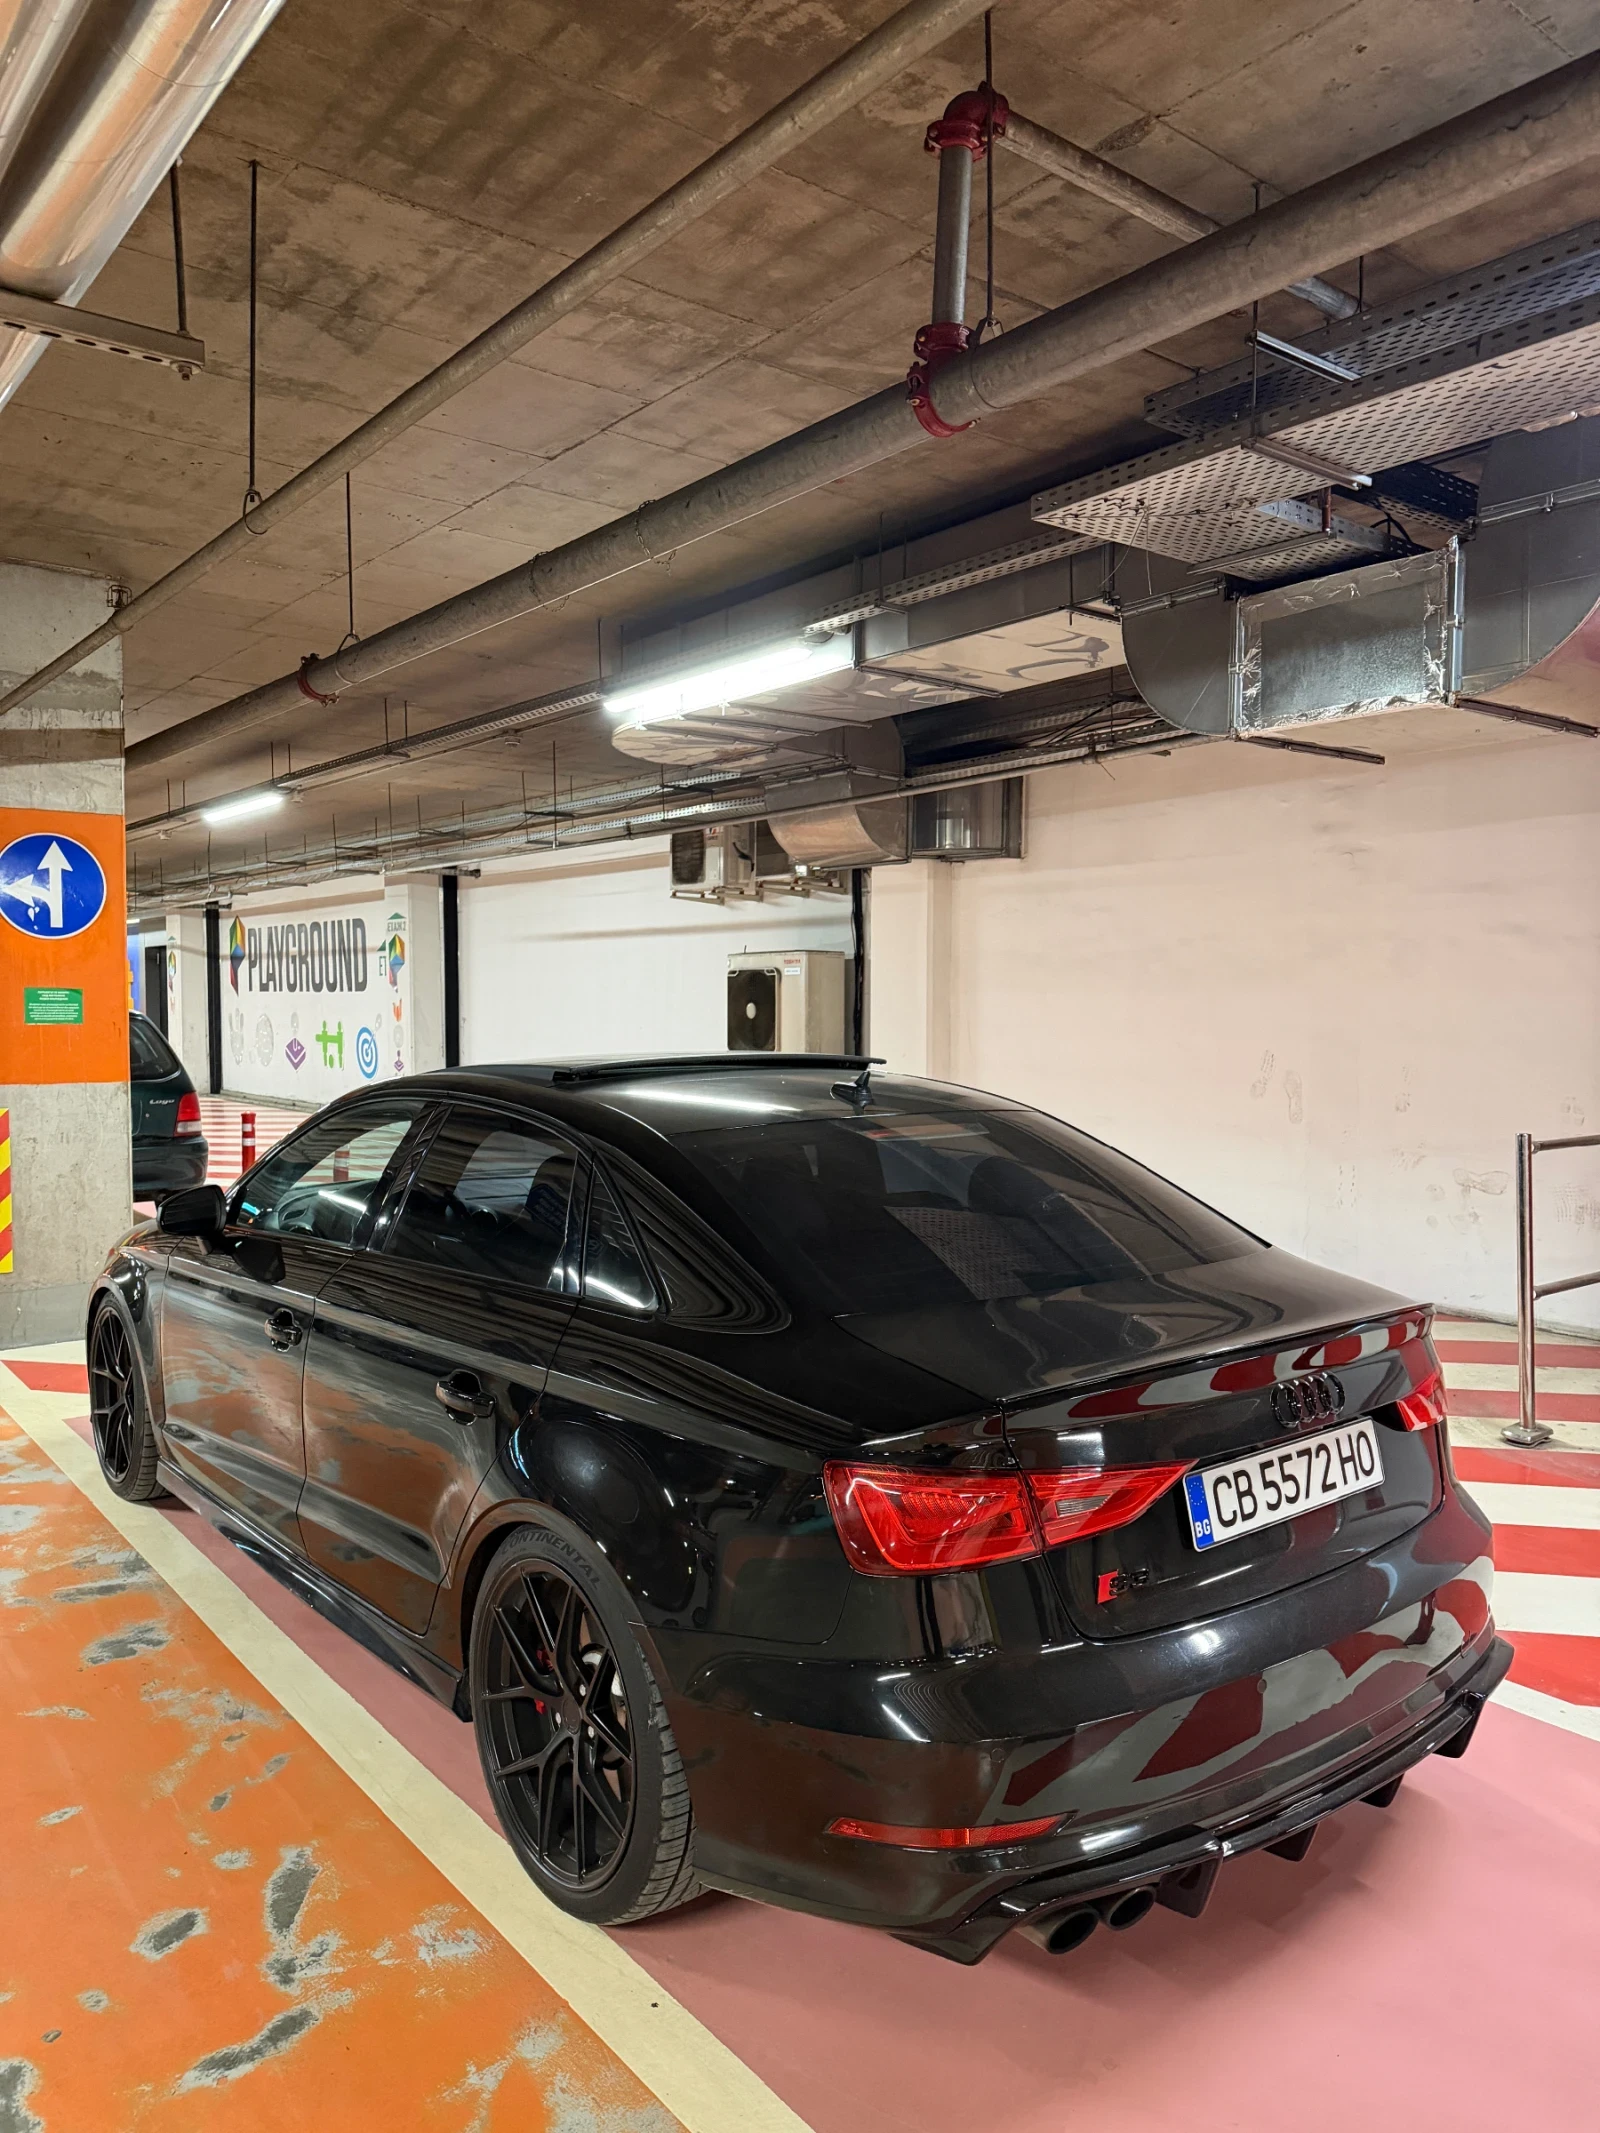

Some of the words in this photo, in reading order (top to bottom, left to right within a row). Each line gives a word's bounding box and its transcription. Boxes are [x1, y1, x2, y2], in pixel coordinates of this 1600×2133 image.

[247, 917, 368, 993] PLAYGROUND
[1212, 1468, 1258, 1529] CB
[1259, 1442, 1338, 1512] 5572
[1334, 1429, 1375, 1487] HO
[501, 1530, 601, 1591] CONTINENTAL
[1194, 1518, 1211, 1538] BG
